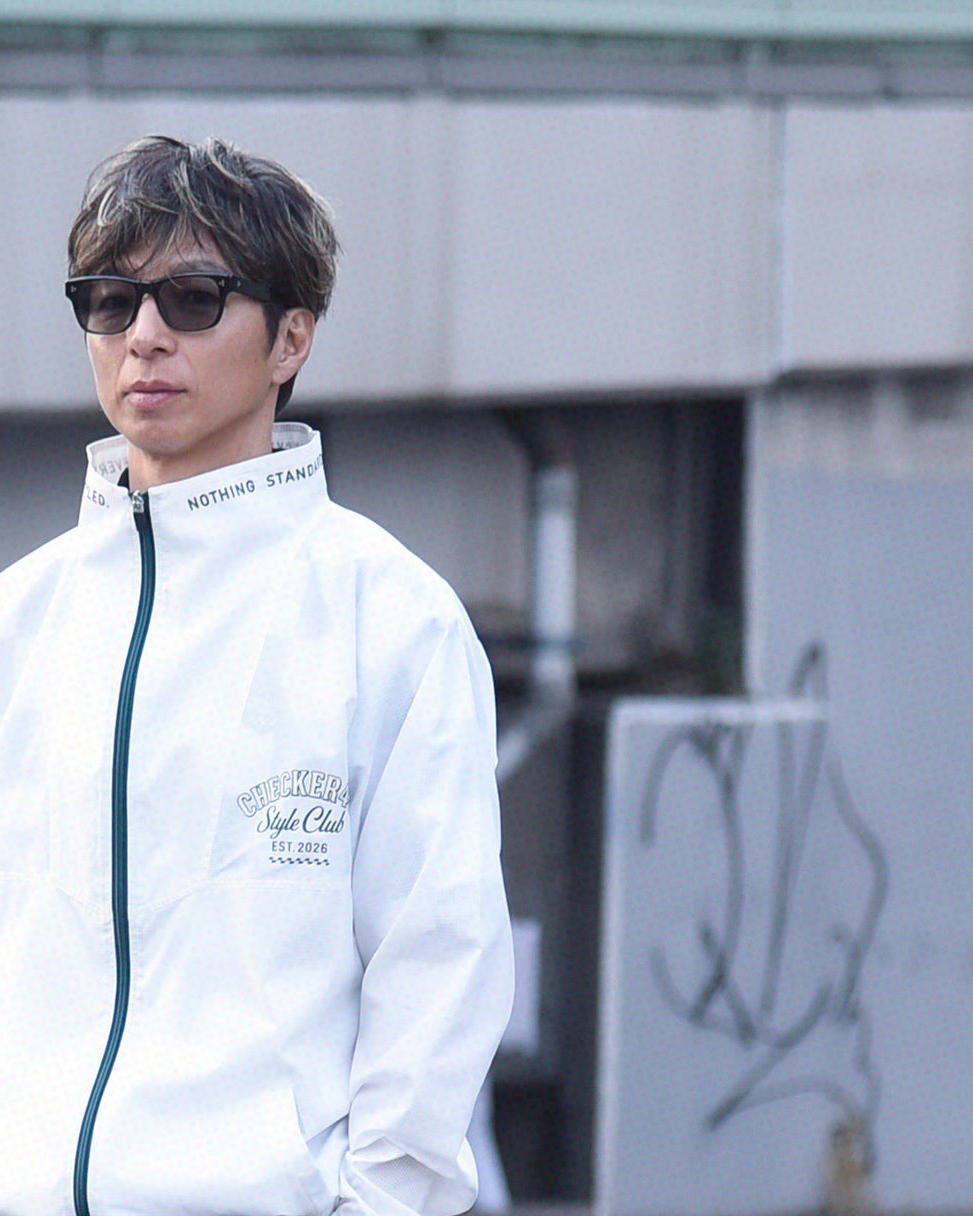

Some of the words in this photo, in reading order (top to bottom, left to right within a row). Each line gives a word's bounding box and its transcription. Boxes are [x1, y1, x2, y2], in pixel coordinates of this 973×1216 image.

[86, 485, 110, 508] LED.
[187, 480, 255, 511] NOTHING
[257, 805, 301, 840] Style
[302, 805, 346, 834] Club
